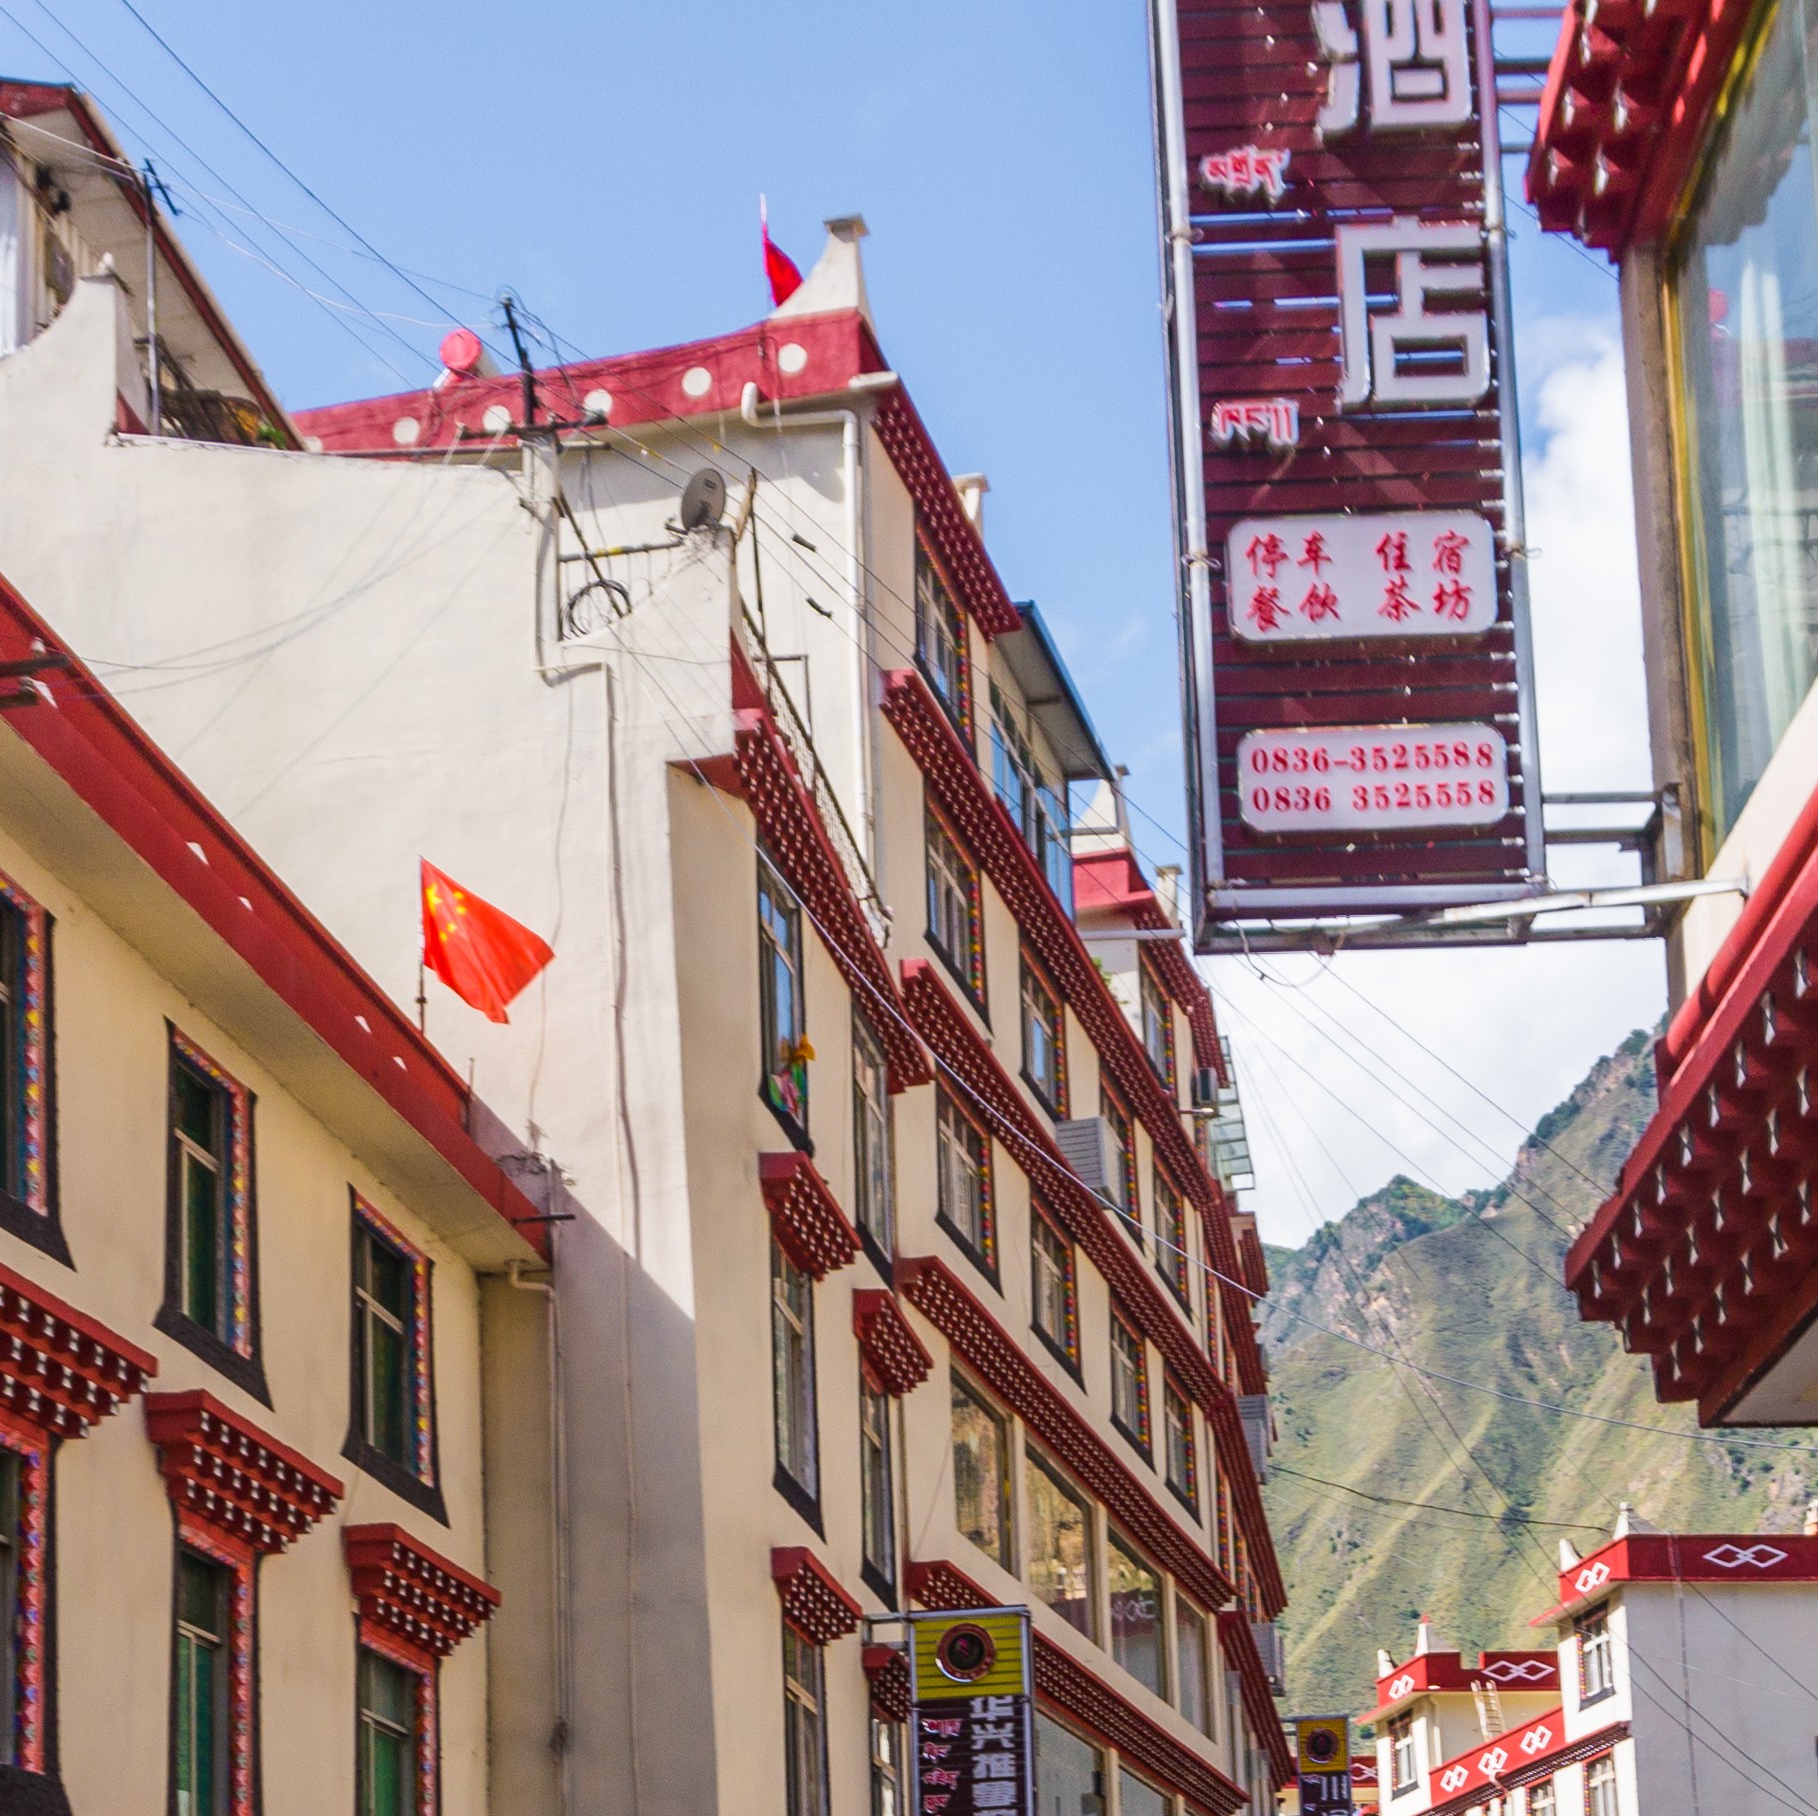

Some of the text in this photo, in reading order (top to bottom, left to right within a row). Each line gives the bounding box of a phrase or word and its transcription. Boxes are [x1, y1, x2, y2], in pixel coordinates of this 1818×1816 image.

[1245, 528, 1470, 579] 停车 住宿
[1247, 574, 1474, 632] 餐饮 茶坊
[1252, 779, 1496, 813] 0836 3525558
